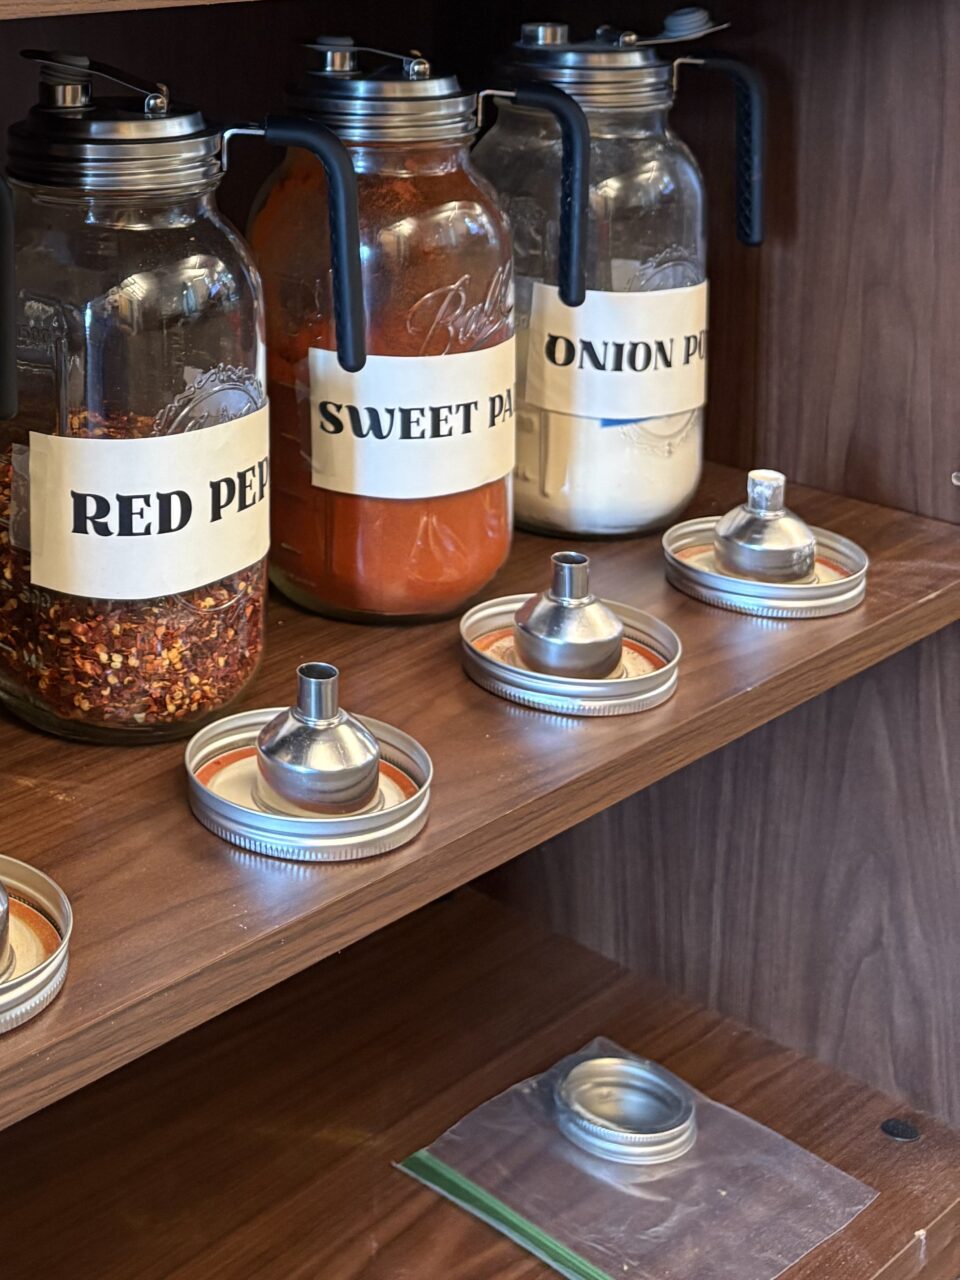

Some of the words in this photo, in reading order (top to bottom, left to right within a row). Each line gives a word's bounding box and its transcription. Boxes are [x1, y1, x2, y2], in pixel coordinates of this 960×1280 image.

[545, 332, 674, 372] ONION
[318, 400, 479, 440] SWEET
[70, 489, 193, 538] RED
